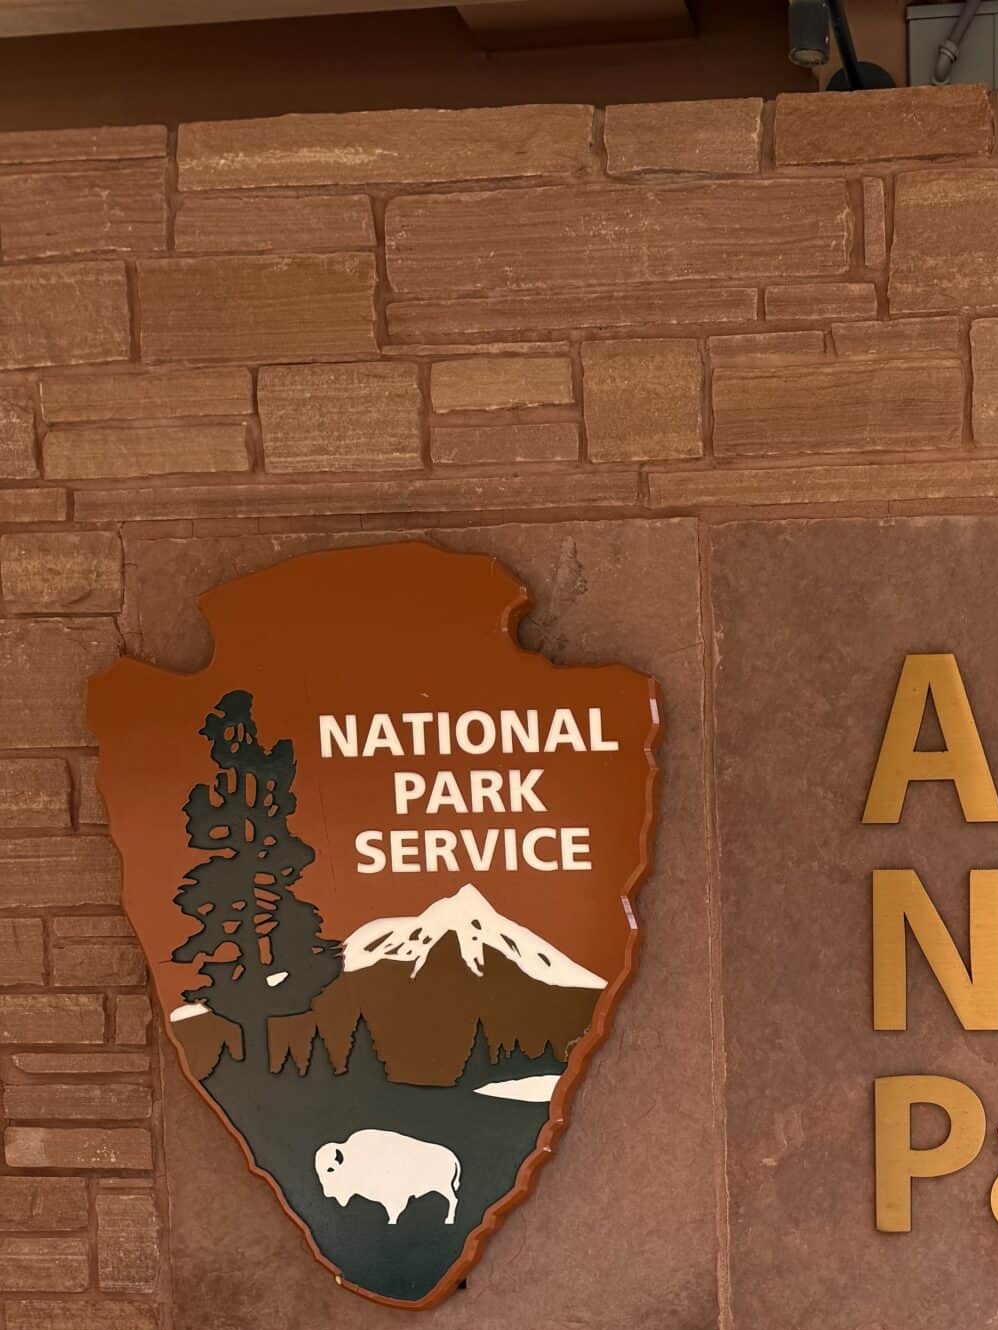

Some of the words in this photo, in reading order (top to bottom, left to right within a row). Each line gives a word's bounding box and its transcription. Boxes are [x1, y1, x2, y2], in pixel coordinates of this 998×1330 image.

[319, 708, 619, 758] NATIONAL
[394, 769, 548, 815] PARK
[355, 828, 592, 874] SERVICE
